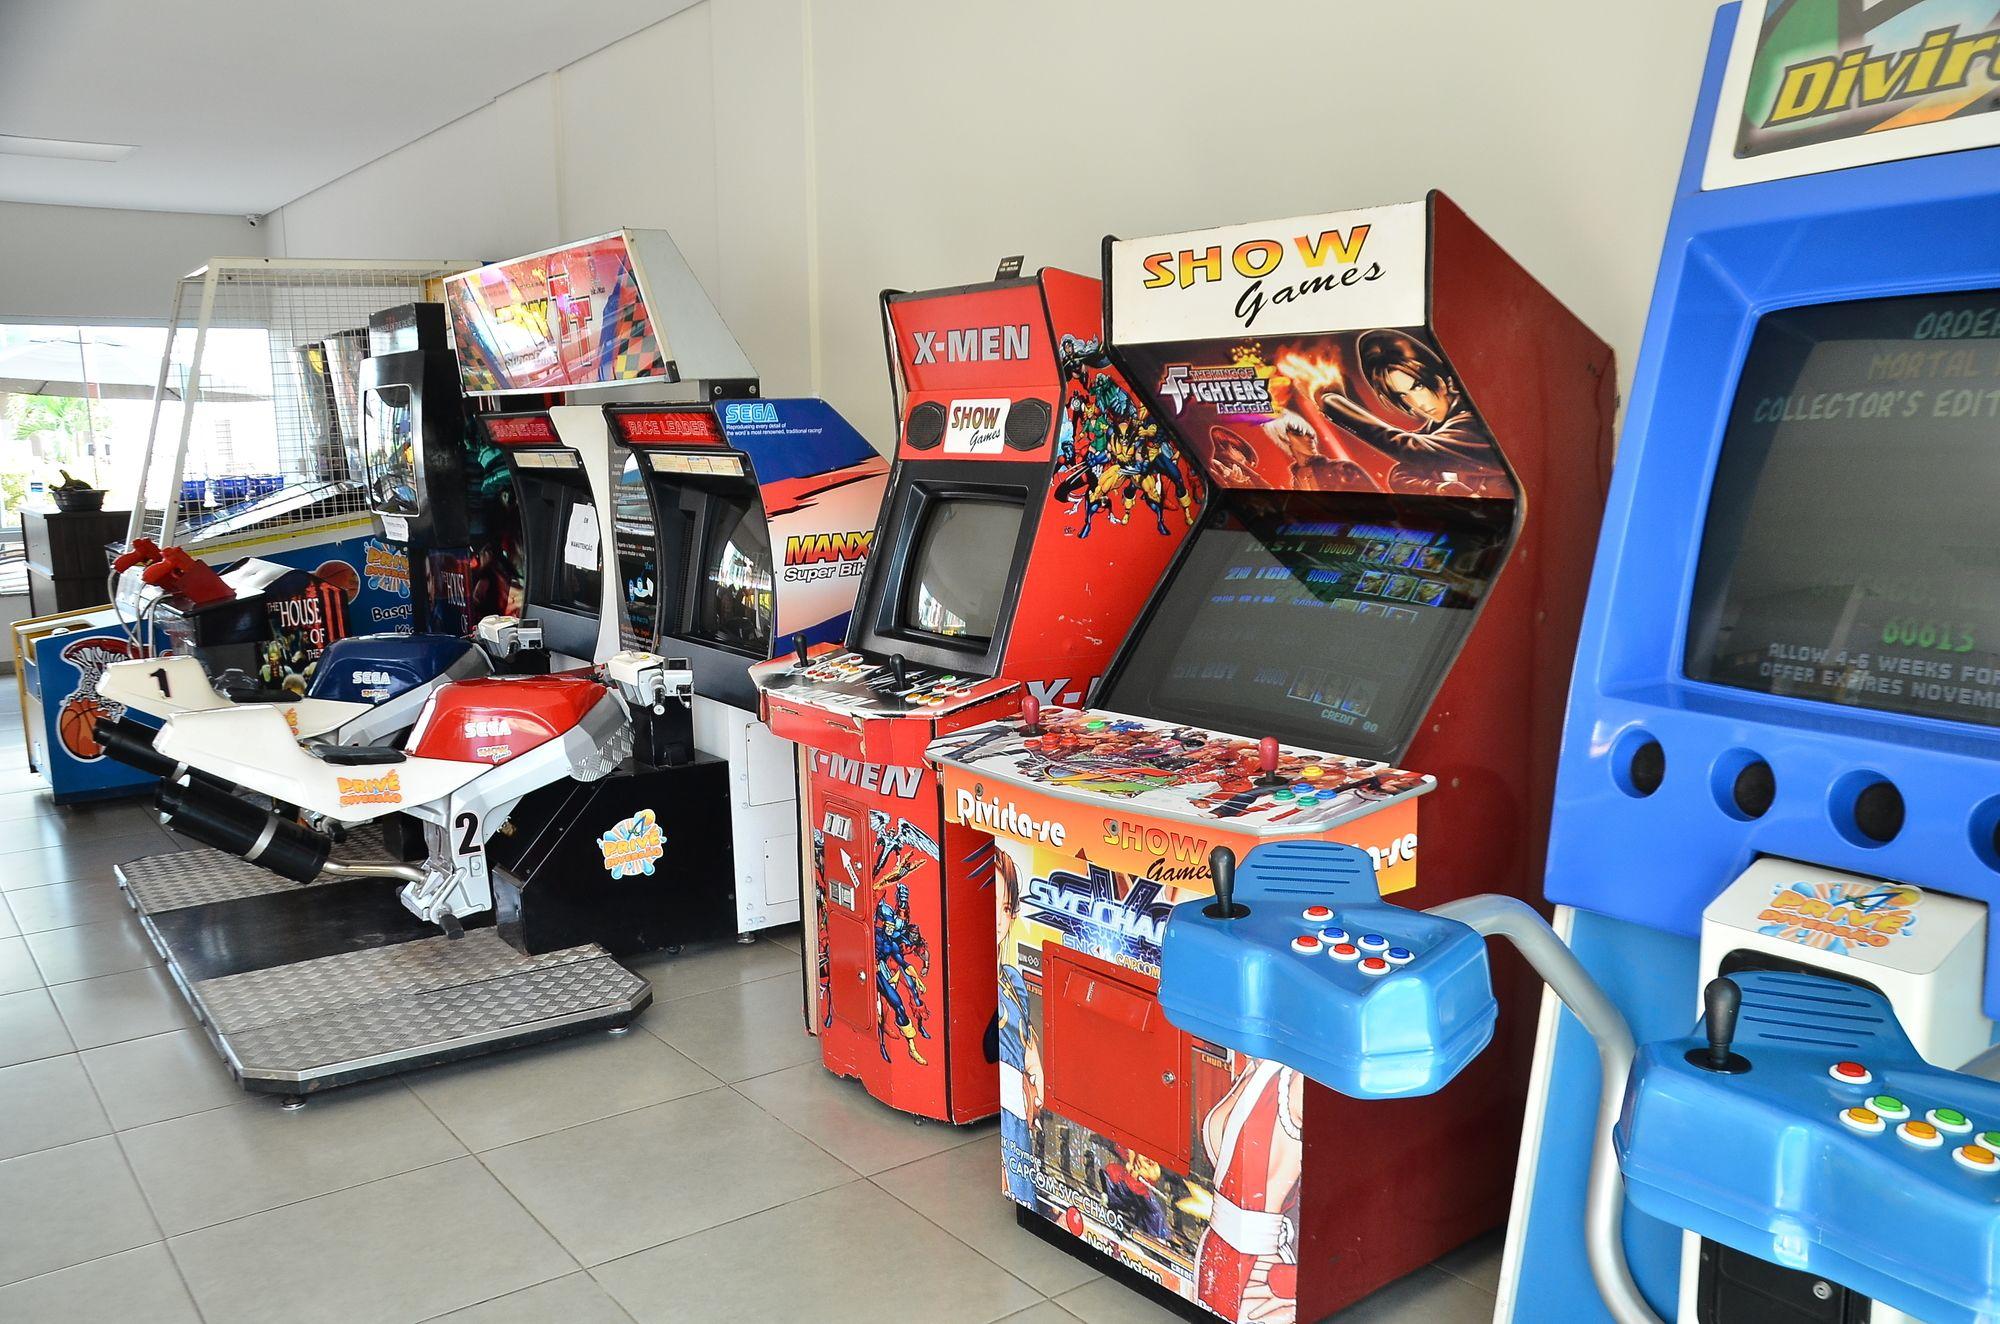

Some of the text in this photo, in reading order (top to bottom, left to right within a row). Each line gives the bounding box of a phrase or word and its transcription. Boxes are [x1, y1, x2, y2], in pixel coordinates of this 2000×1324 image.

[1760, 24, 2000, 129] Divir
[1143, 223, 1372, 290] SHOW
[1234, 261, 1386, 328] Games
[912, 323, 1031, 366] X-MEN
[1189, 367, 1256, 382] THE KING OF
[1867, 350, 1982, 381] MORTAL
[1160, 366, 1270, 416] FIGHTERS
[1753, 390, 1926, 423] COLLECTOR'S
[725, 402, 779, 424] SEGA
[951, 406, 1001, 432] SHOW
[1216, 400, 1275, 415] Android
[628, 420, 708, 436] RACE LEADER
[969, 428, 1001, 454] Games
[784, 530, 875, 566] MANX
[784, 566, 836, 583] Super
[267, 602, 280, 613] THE
[279, 597, 323, 628] HOUSE
[310, 627, 325, 645] OF
[1768, 641, 1828, 664] ALLOW
[1835, 650, 1871, 671] 4-6
[1878, 655, 1954, 681] WEEKS
[150, 667, 172, 698] 1
[351, 670, 391, 685] SEGA
[1760, 661, 1816, 683] OFFER
[1909, 681, 2000, 710] NOVEM
[464, 719, 512, 738] SEGA
[1321, 707, 1357, 727] CREDIT
[336, 768, 402, 795] PRIVÉ
[455, 812, 482, 856] 2
[602, 824, 662, 858] PRIVÉ
[1102, 816, 1208, 866] SHOW
[1770, 889, 1912, 935] PRIVÉ
[1757, 908, 1890, 948] DIVERSÃO
[1115, 953, 1161, 979] CAPCOM
[1010, 1139, 1042, 1170] Playmore
[1083, 1196, 1124, 1232] CHAOS
[1086, 1231, 1114, 1257] Next
[1119, 1251, 1163, 1284] System
